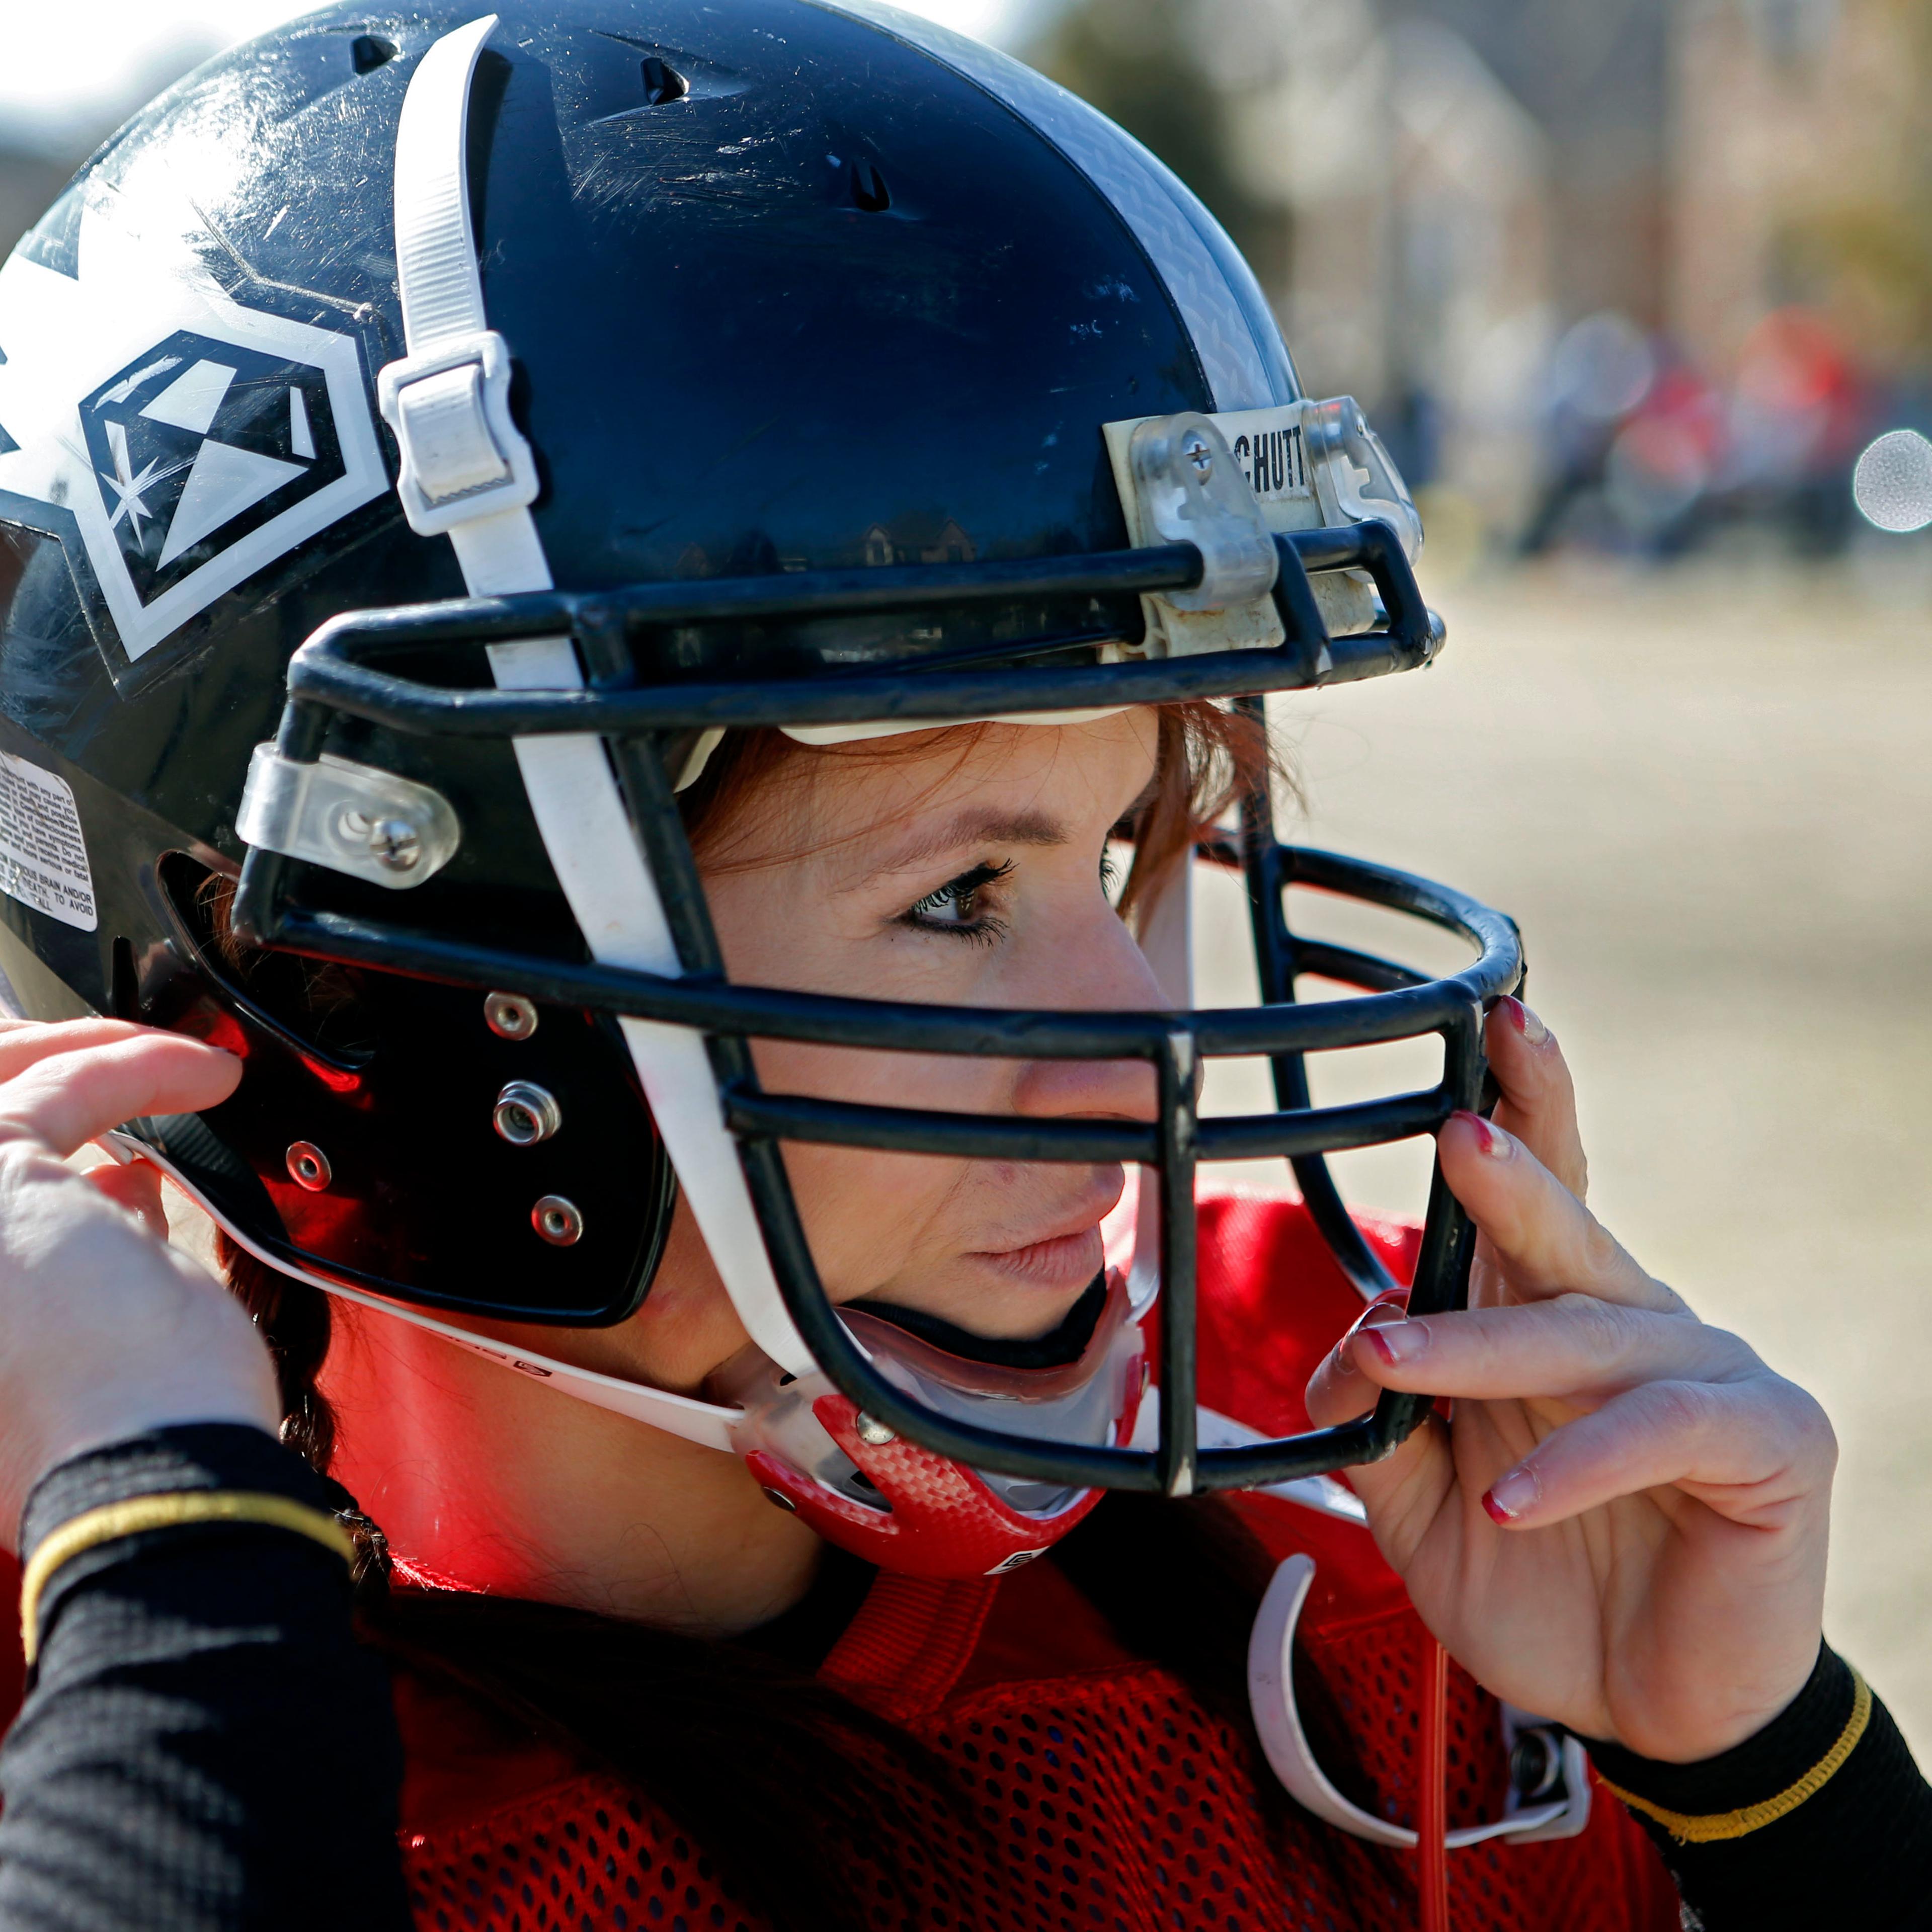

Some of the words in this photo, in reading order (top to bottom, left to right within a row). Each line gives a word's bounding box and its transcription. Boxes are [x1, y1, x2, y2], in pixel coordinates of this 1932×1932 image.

[43, 797, 61, 810] cause
[63, 806, 75, 816] you
[52, 793, 65, 804] part
[51, 810, 77, 825] possible
[35, 819, 81, 844] consciousness
[62, 846, 71, 857] Do
[74, 854, 85, 863] not
[65, 867, 71, 875] or
[74, 870, 89, 881] fatal
[39, 872, 61, 892] BRAIN
[63, 885, 92, 905] AND/OR
[54, 892, 65, 905] TO
[70, 899, 94, 916] AVOID
